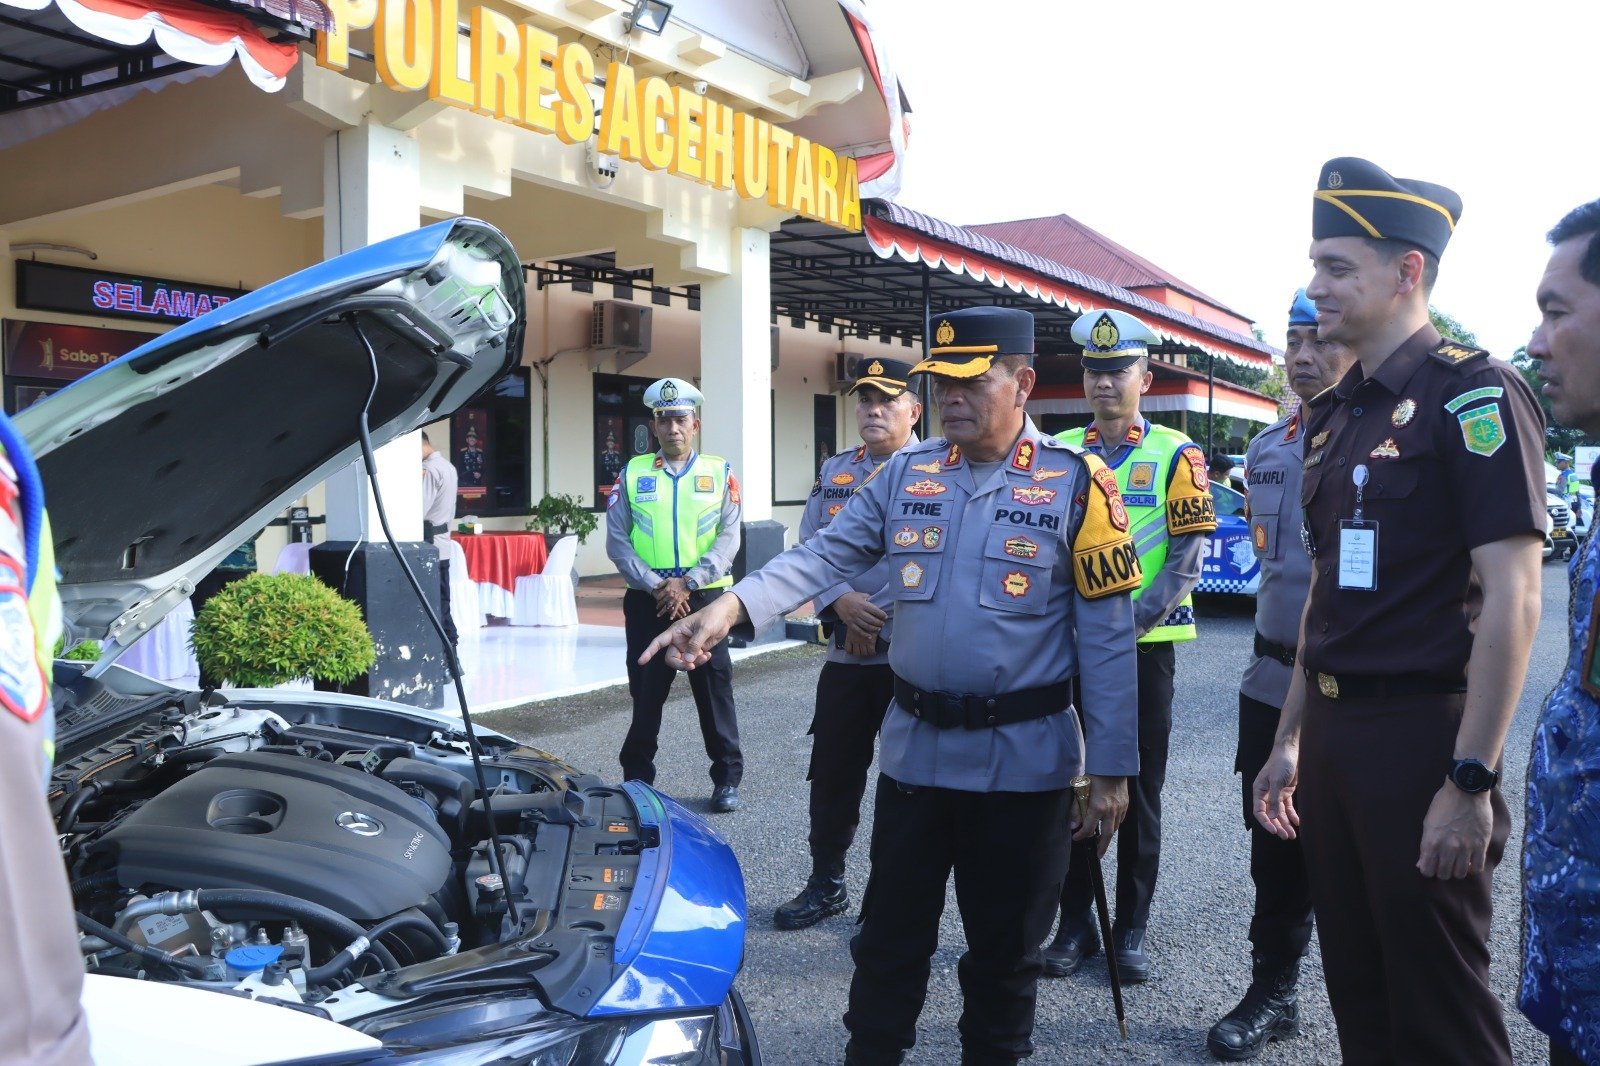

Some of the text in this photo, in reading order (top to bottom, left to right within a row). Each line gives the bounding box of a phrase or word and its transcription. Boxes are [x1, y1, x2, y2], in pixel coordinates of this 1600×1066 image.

[316, 0, 862, 232] POLRES ACEH UTARA
[93, 281, 230, 319] SELAMAT
[60, 348, 98, 363] Sabe
[901, 502, 942, 517] TRIE
[1123, 496, 1155, 505] POLRI
[994, 508, 1060, 531] POLRI
